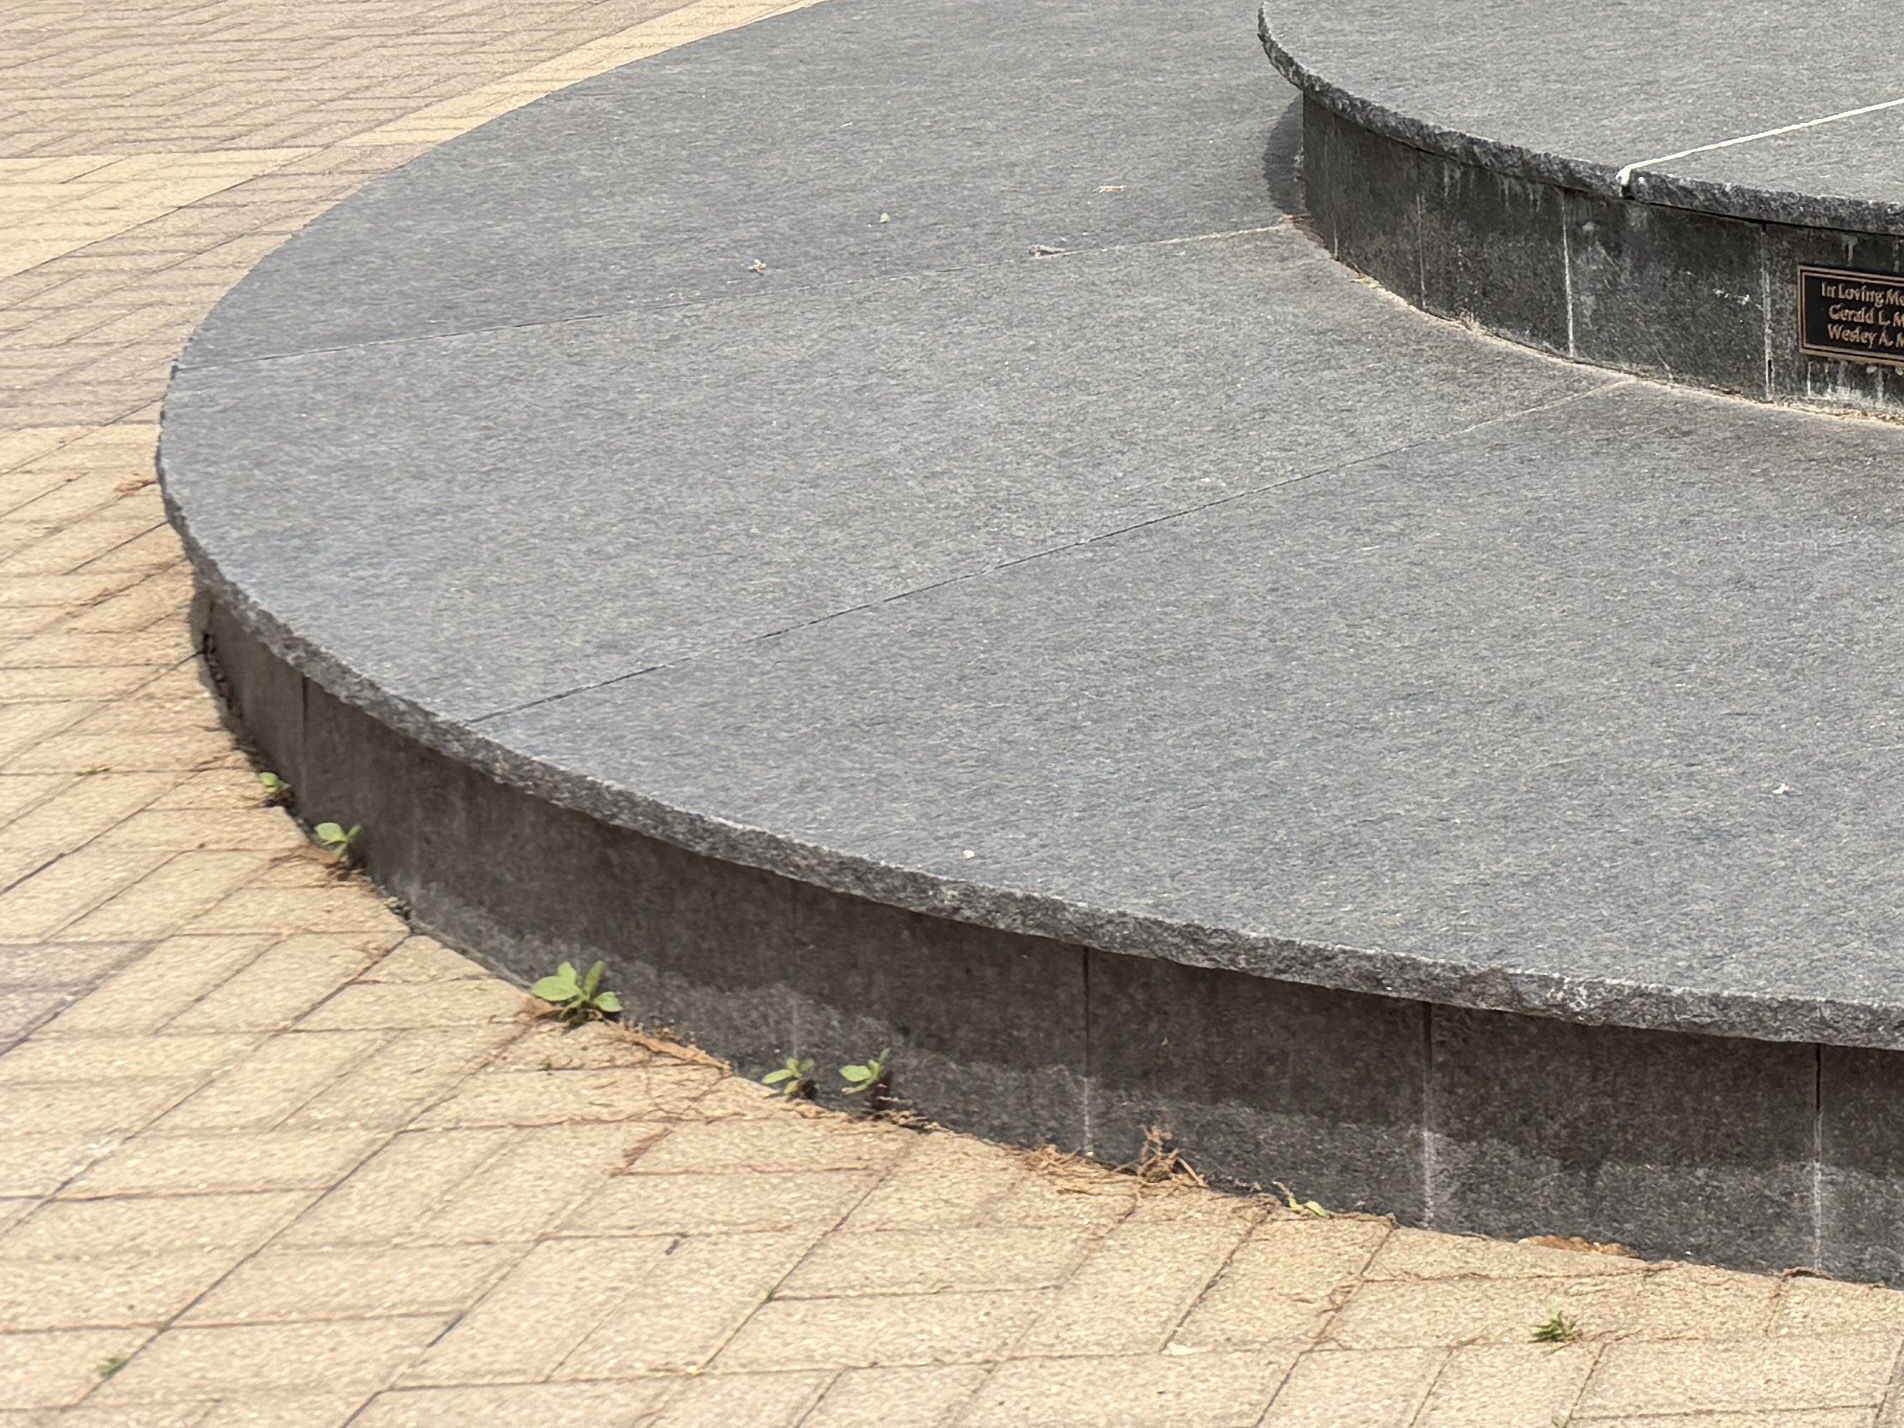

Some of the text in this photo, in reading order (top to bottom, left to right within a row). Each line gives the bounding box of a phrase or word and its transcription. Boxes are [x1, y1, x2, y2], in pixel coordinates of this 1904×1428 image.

[1821, 281, 1836, 298] In
[1838, 283, 1884, 307] Loving
[1828, 304, 1874, 324] Gerald
[1878, 311, 1891, 326] L.
[1827, 324, 1876, 348] Wesley
[1878, 331, 1893, 347] A.
